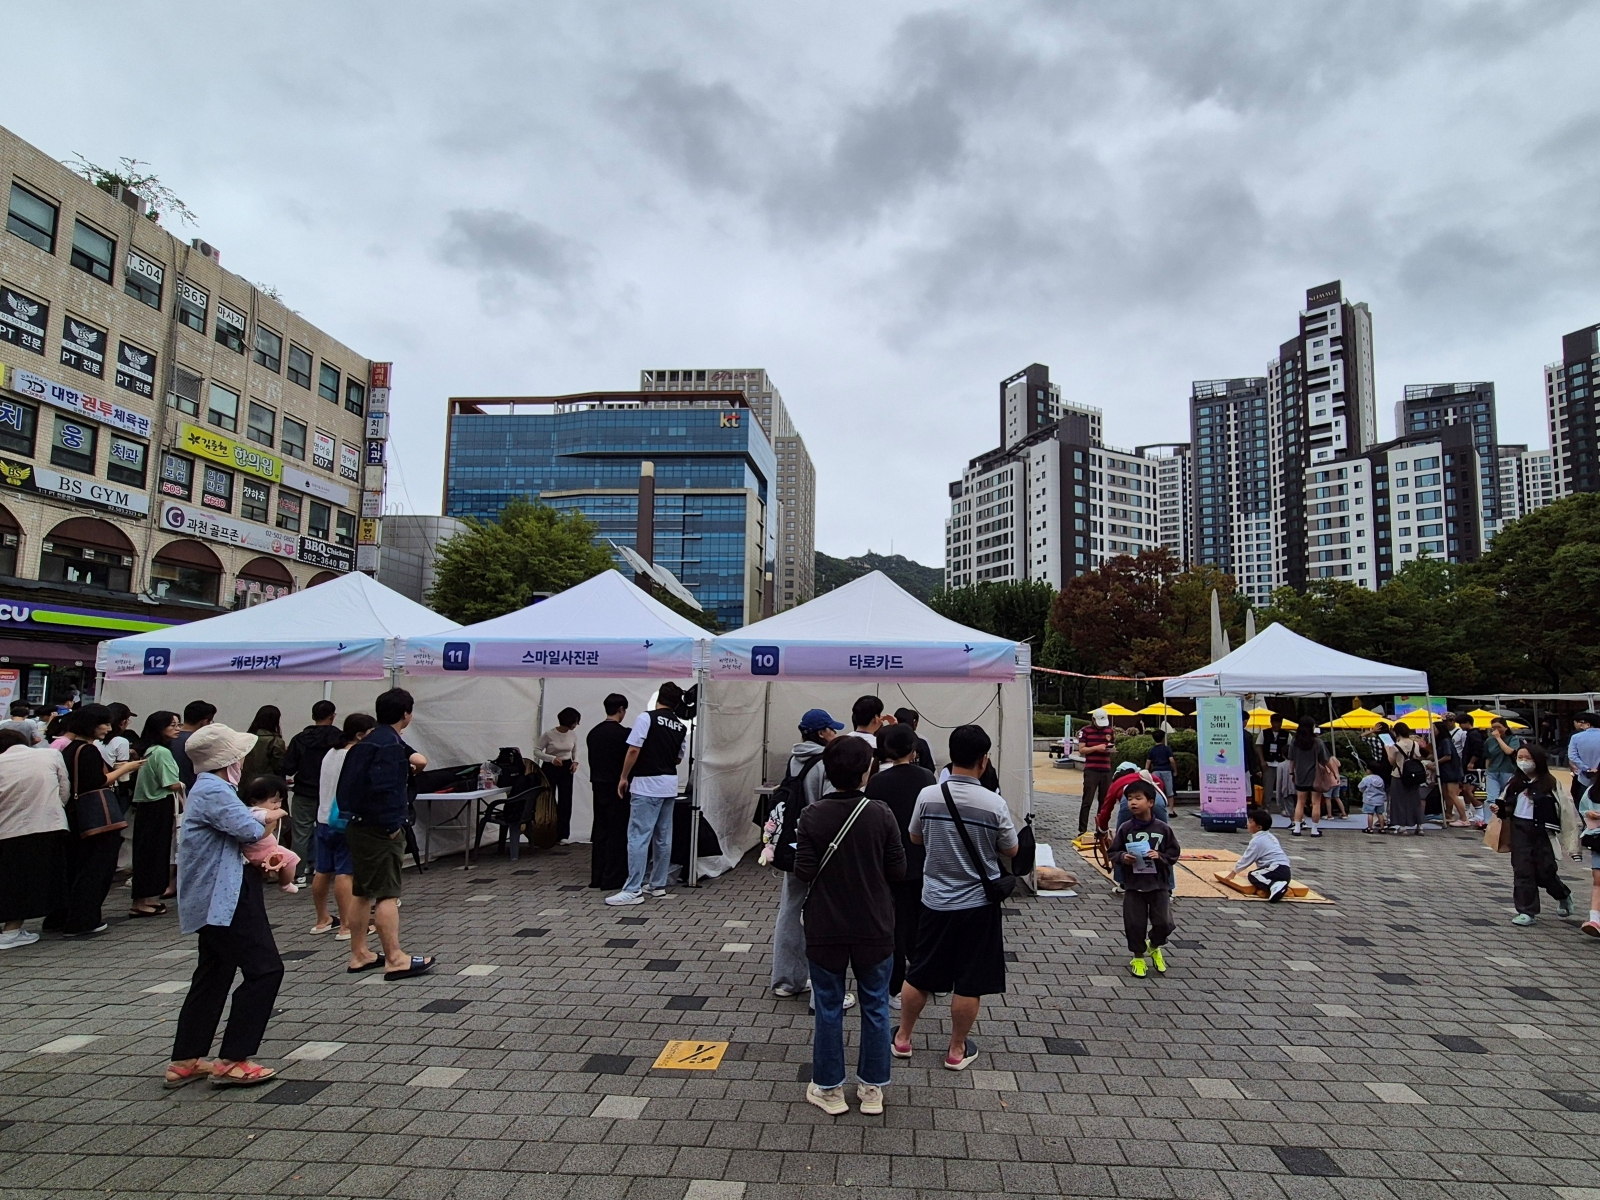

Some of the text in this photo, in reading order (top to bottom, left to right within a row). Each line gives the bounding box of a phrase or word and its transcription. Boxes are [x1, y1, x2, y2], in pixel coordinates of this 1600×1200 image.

[217, 305, 244, 327] 마사지
[0, 324, 42, 350] PT 전문
[62, 351, 101, 375] PT 전문
[116, 375, 152, 395] PT 전문
[370, 419, 379, 437] 치과
[720, 411, 740, 428] kt
[61, 423, 84, 449] 웅
[111, 441, 140, 465] 치과
[370, 441, 382, 459] 치과
[233, 445, 274, 477] 한의원
[313, 456, 332, 469] 507-
[8, 467, 22, 478] BS
[340, 465, 357, 480] 0594
[58, 476, 130, 507] BS GYM
[203, 494, 227, 508] 5630
[187, 518, 240, 542] 과천 골프존
[265, 529, 295, 543] 02-502-0802
[304, 538, 330, 557] BBQ
[326, 546, 350, 559] Chicken
[303, 552, 337, 567] 502-3640
[0, 604, 29, 622] CU
[148, 655, 165, 668] 12
[448, 650, 463, 663] 11
[521, 649, 600, 666] 스마일사진관
[755, 654, 774, 668] 10
[849, 654, 904, 670] 타로카드
[656, 715, 683, 732] STAFF
